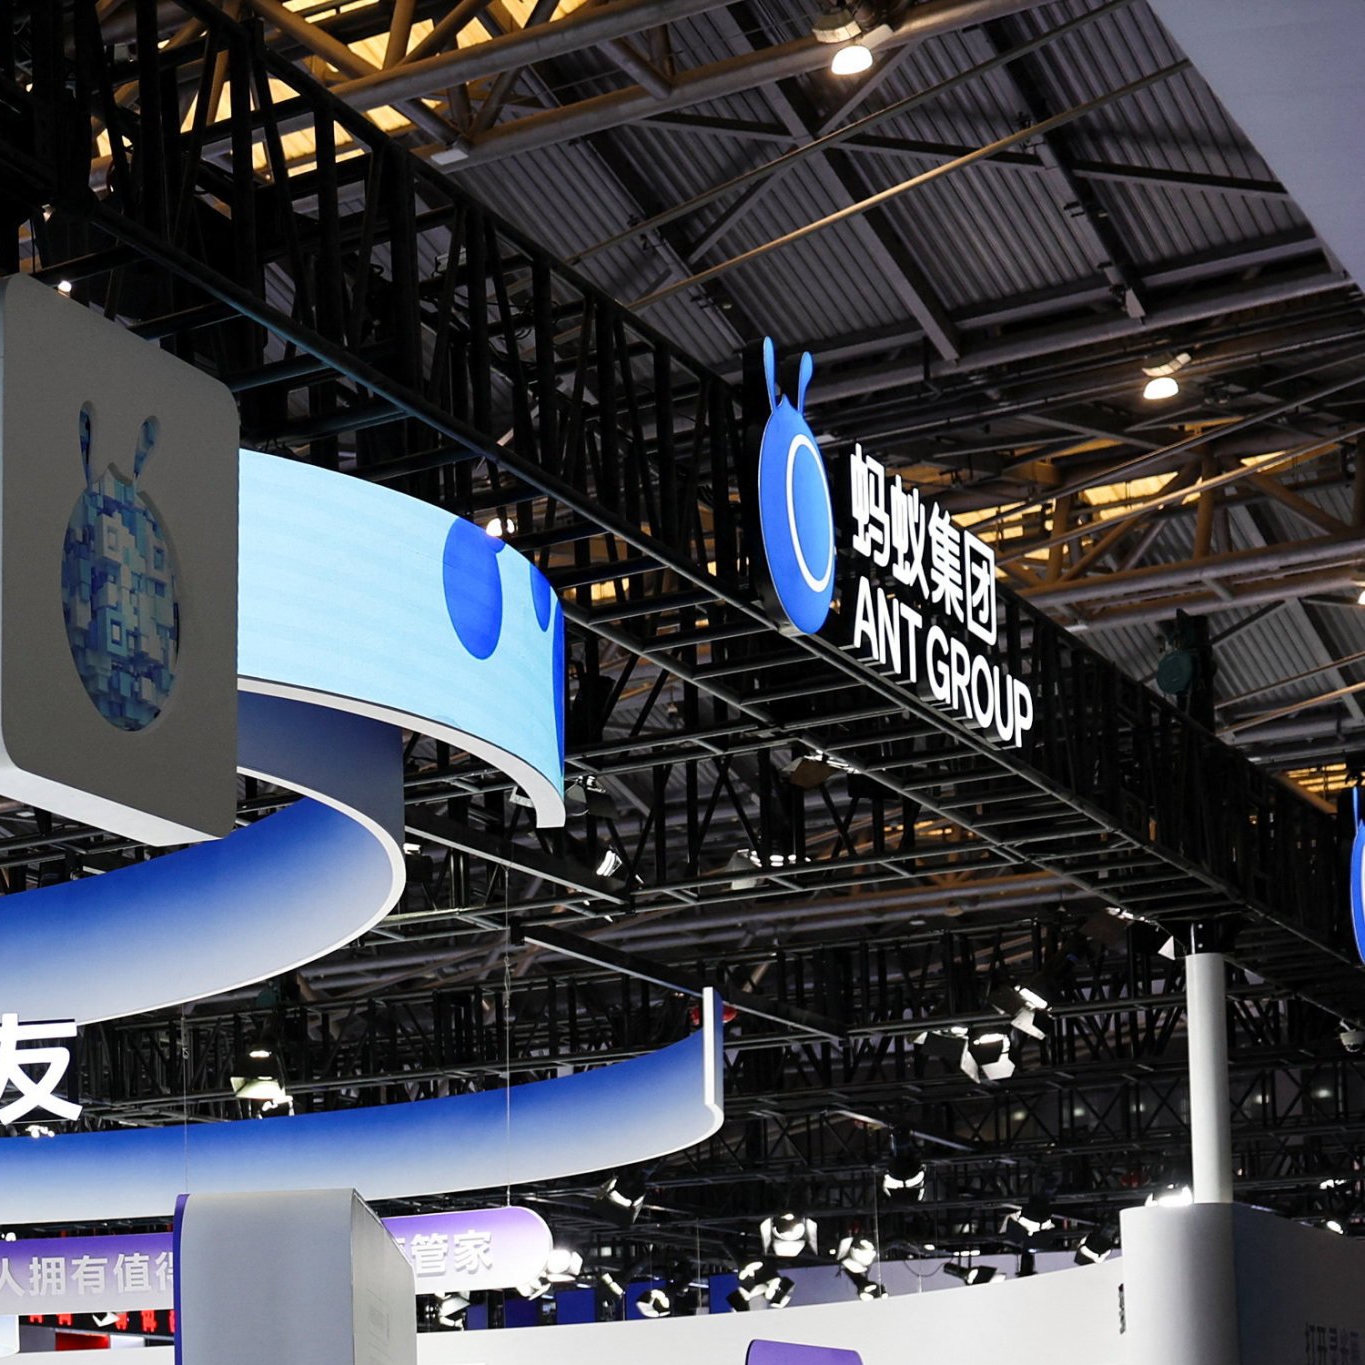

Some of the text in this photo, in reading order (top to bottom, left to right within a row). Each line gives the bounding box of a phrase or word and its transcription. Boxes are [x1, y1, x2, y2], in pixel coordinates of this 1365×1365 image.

[850, 443, 998, 647] 蚂蚁集团
[853, 576, 1034, 749] ANT GROUP
[394, 1229, 493, 1277] 管家
